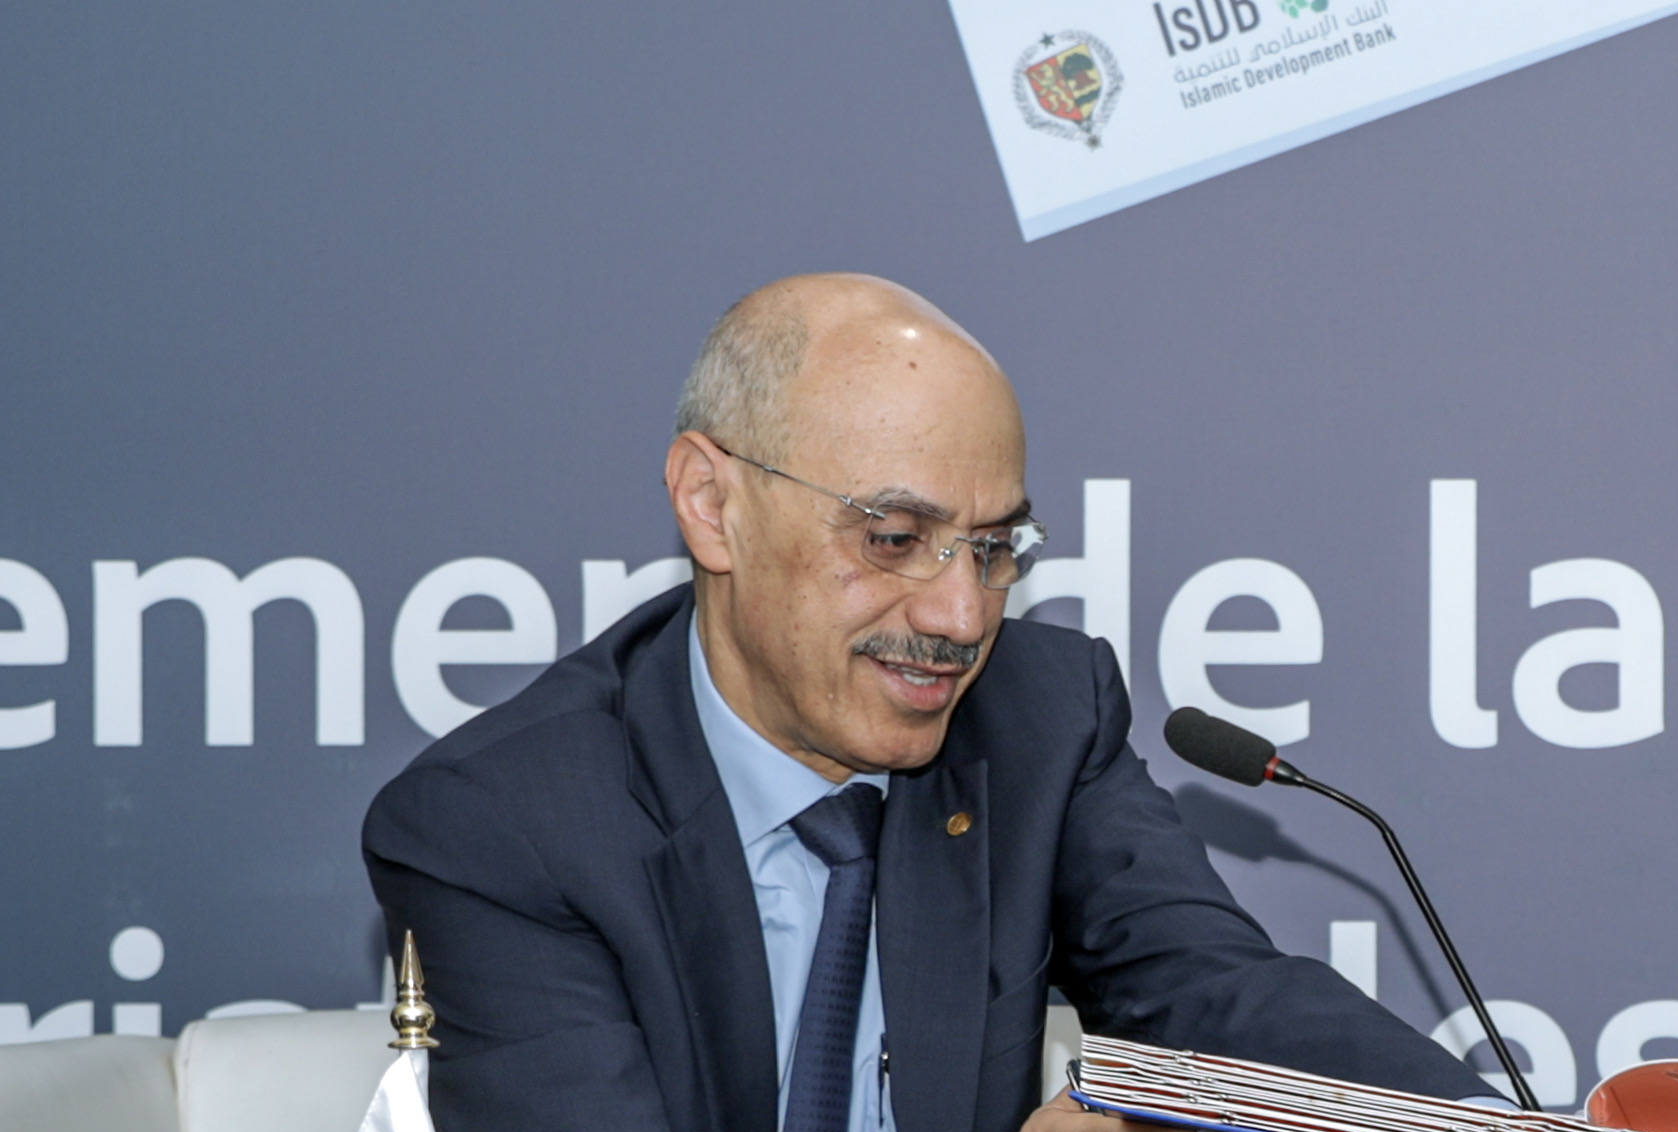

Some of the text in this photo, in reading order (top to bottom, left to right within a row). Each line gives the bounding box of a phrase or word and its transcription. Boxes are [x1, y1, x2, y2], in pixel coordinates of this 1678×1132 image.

[1153, 0, 1261, 57] IsDB
[1180, 23, 1397, 109] Islamic Development Bank
[1430, 479, 1665, 749] la
